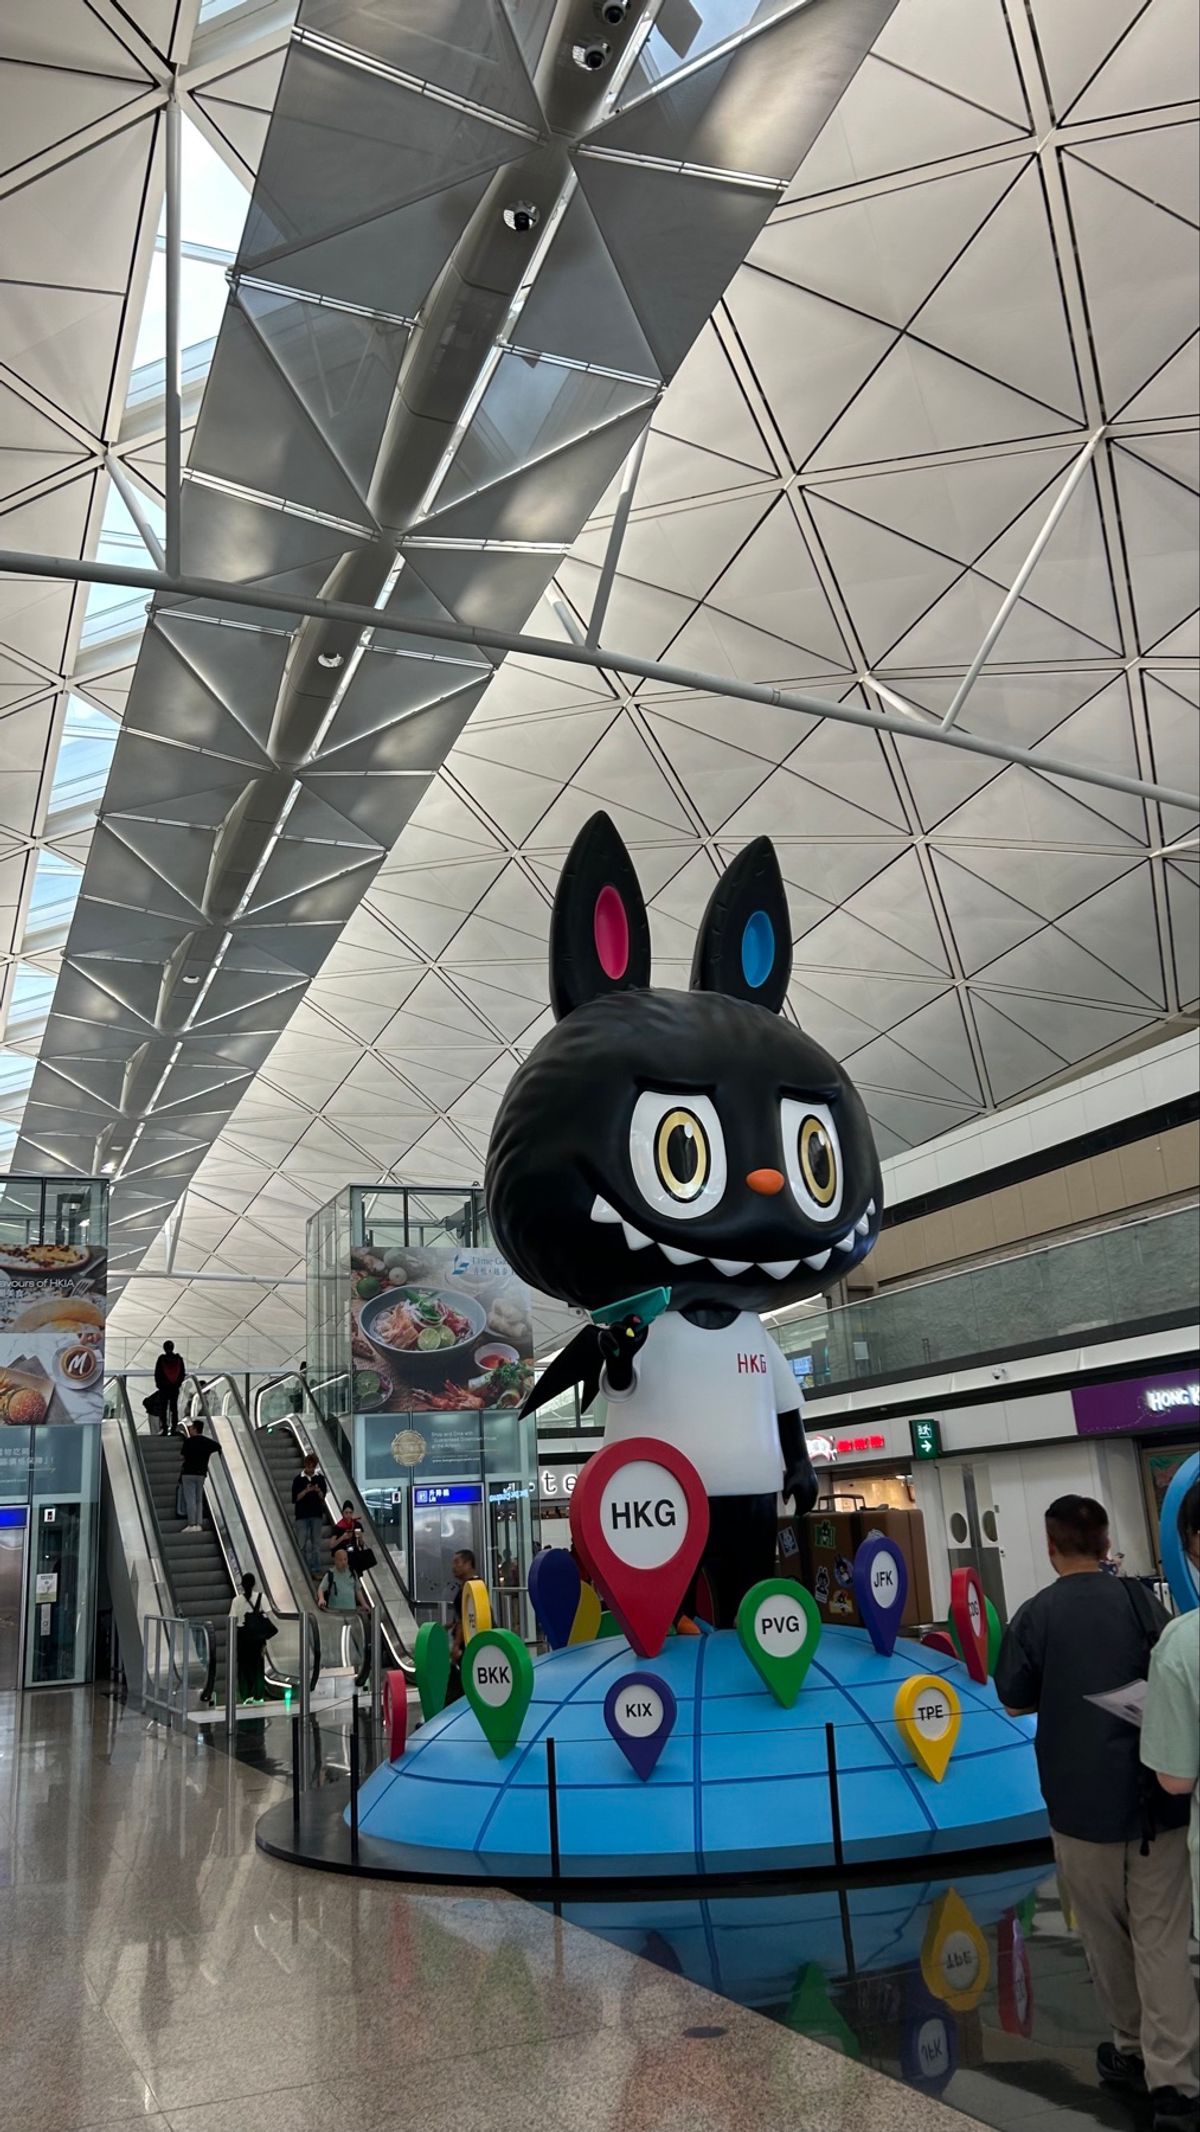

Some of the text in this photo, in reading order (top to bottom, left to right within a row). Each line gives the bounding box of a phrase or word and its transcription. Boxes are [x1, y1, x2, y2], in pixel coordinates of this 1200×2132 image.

[36, 1278, 47, 1288] of
[49, 1278, 74, 1288] HKIA
[737, 1353, 767, 1374] HKG
[1146, 1388, 1190, 1411] HONG
[611, 1499, 676, 1530] HKG
[873, 1571, 894, 1588] JFK
[762, 1615, 800, 1635] PVG
[477, 1666, 511, 1684] BKK
[626, 1703, 653, 1718] KIX
[918, 1704, 944, 1721] TPE
